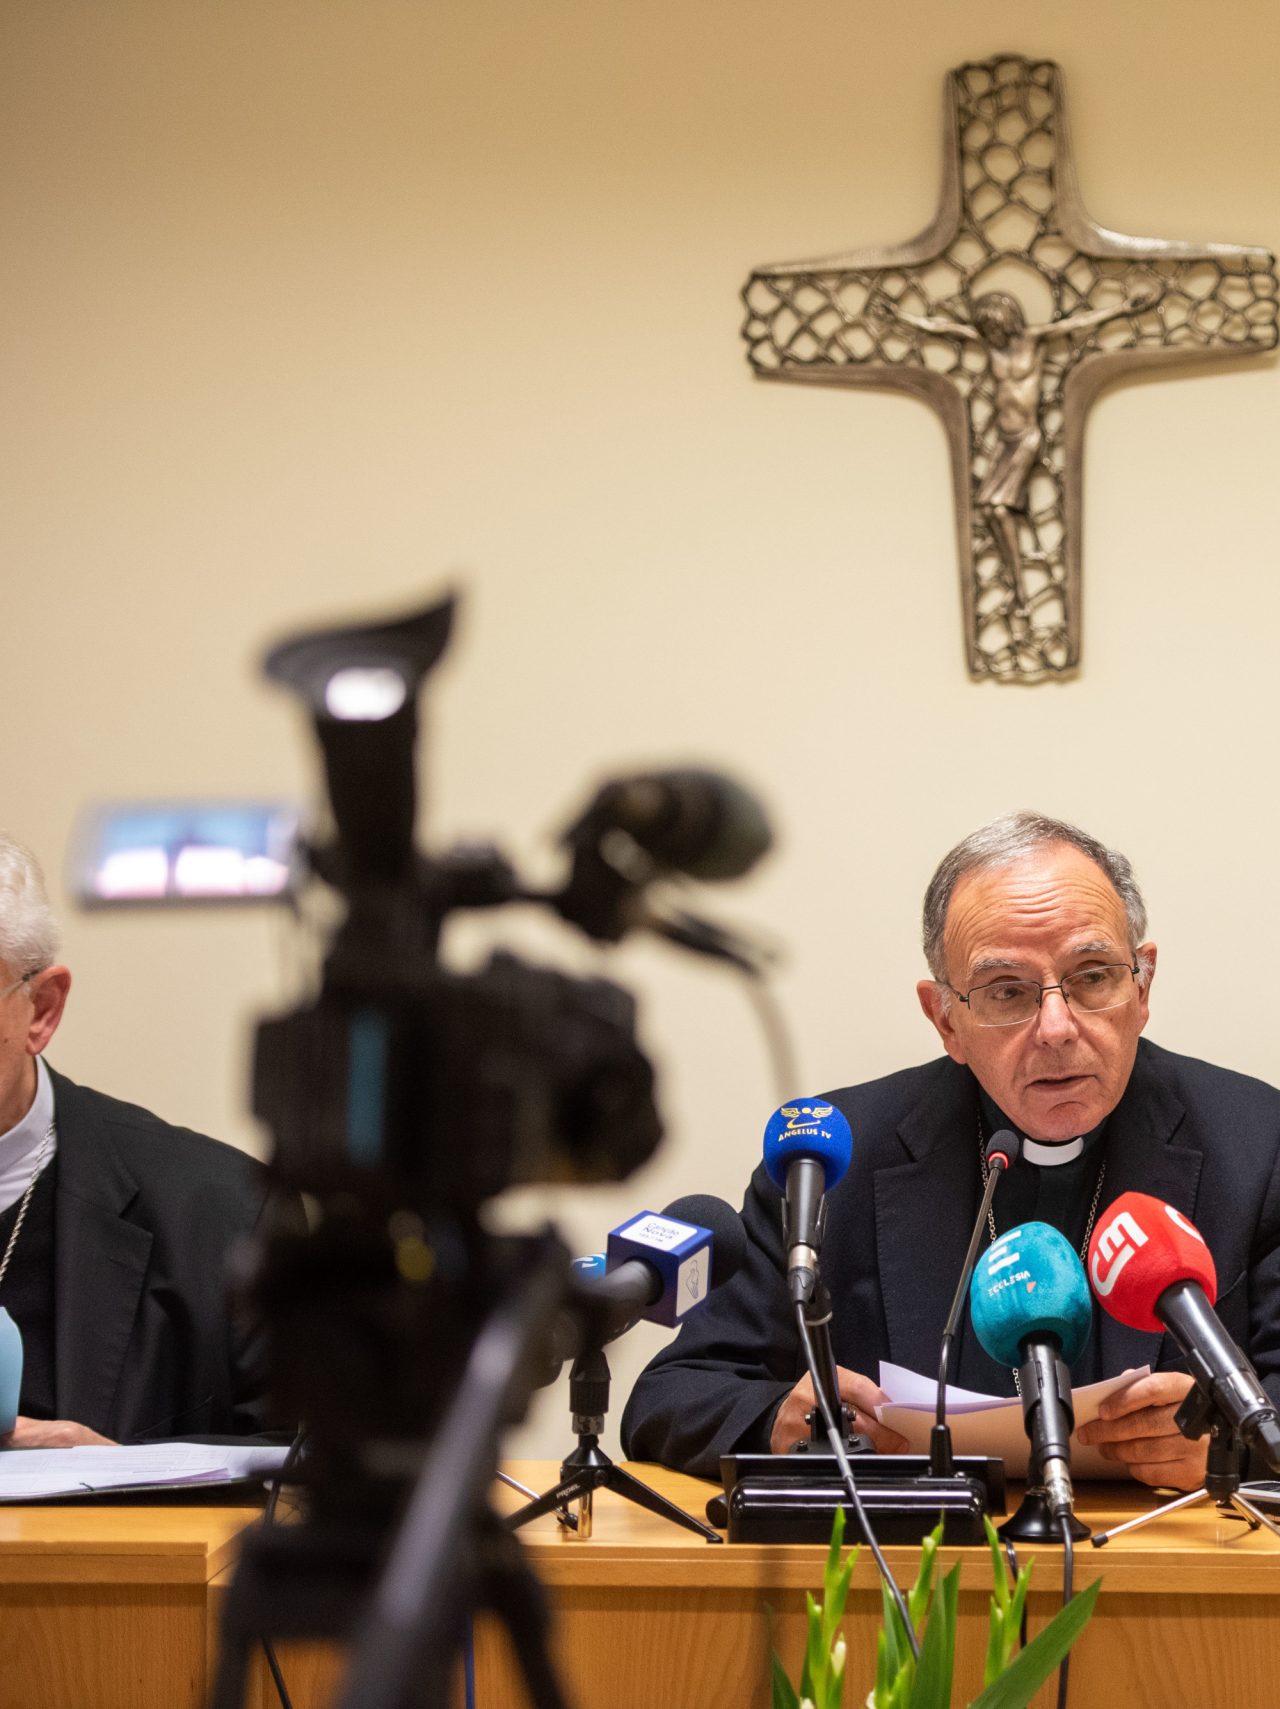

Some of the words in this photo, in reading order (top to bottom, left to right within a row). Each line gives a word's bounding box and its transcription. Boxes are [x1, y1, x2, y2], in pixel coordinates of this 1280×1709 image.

[778, 1128, 818, 1142] ANGELUS
[821, 1130, 832, 1139] TV
[987, 1270, 1031, 1297] ECCLESIA
